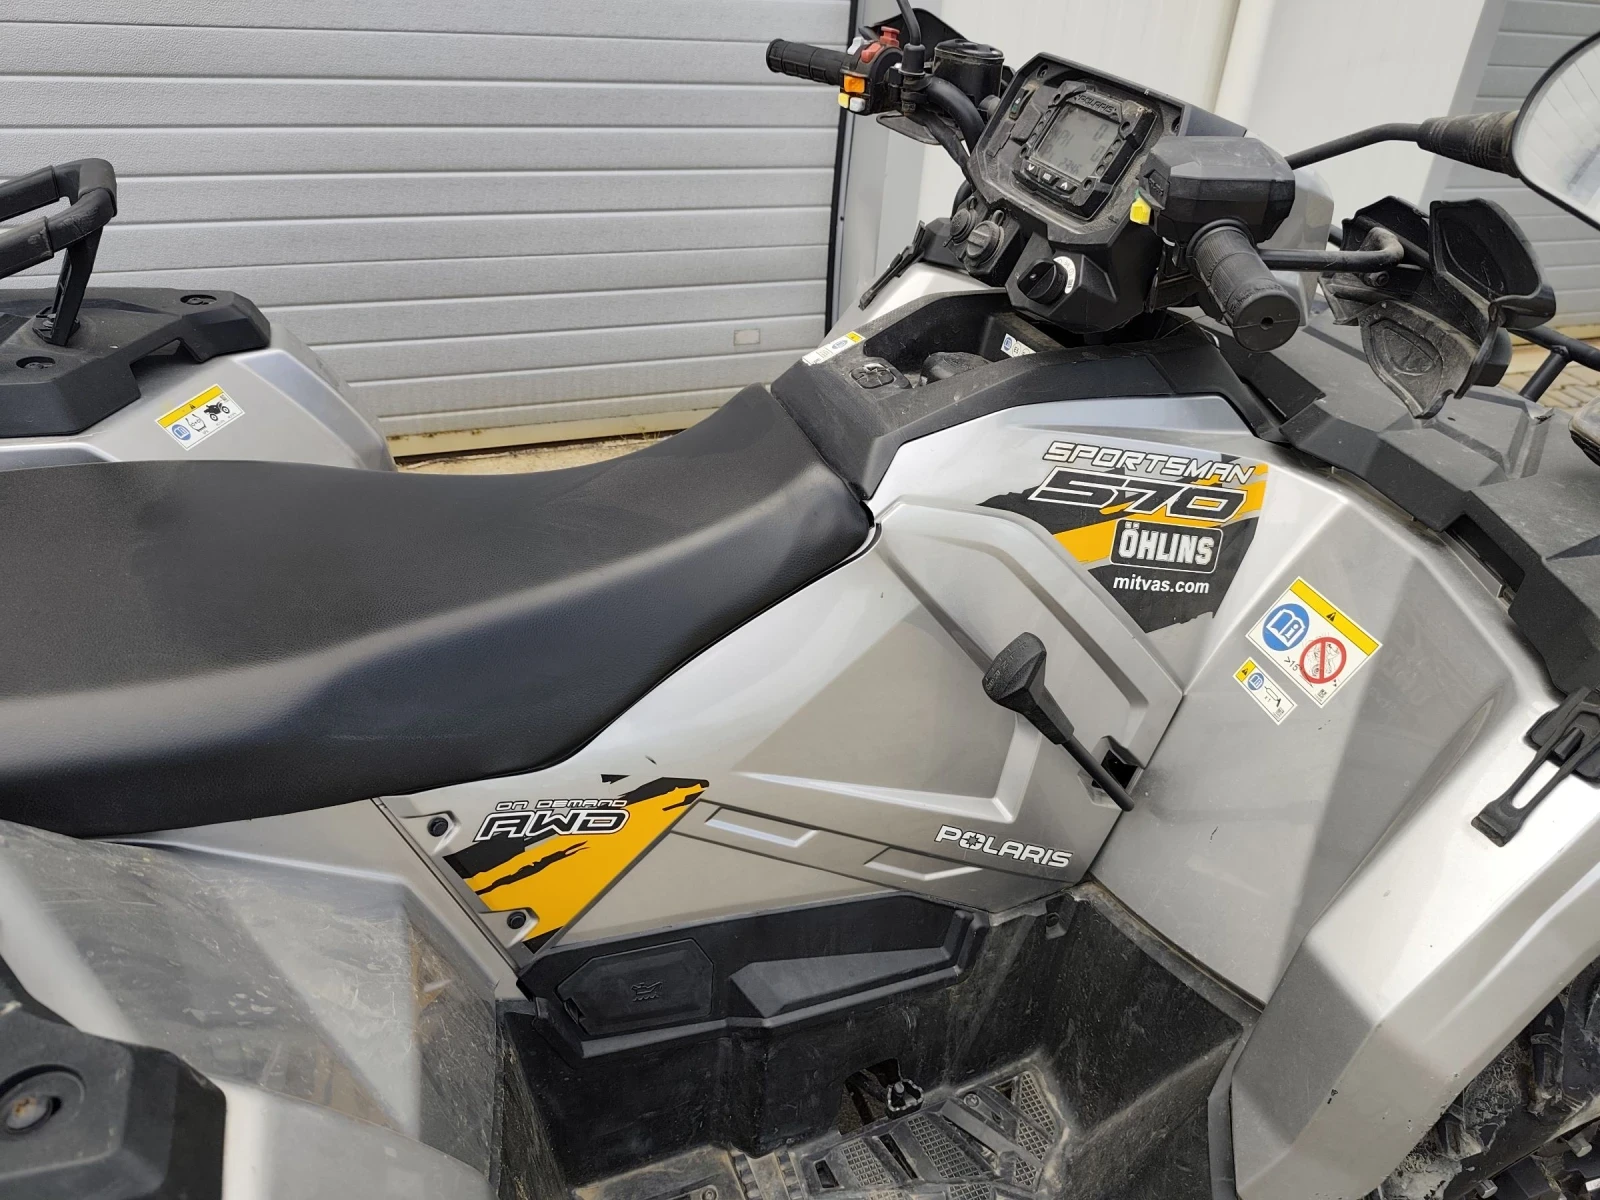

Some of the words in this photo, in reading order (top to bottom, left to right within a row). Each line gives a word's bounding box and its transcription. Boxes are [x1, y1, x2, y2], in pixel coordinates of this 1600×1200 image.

[1042, 440, 1255, 484] SPORTSMAN
[1027, 466, 1248, 522] 570
[1118, 521, 1215, 566] ÖHLINS
[1113, 574, 1210, 594] mitvas.com
[473, 809, 630, 842] AWD
[495, 800, 529, 811] ON
[535, 799, 628, 809] DEMAND
[934, 824, 1073, 868] POLARIS
